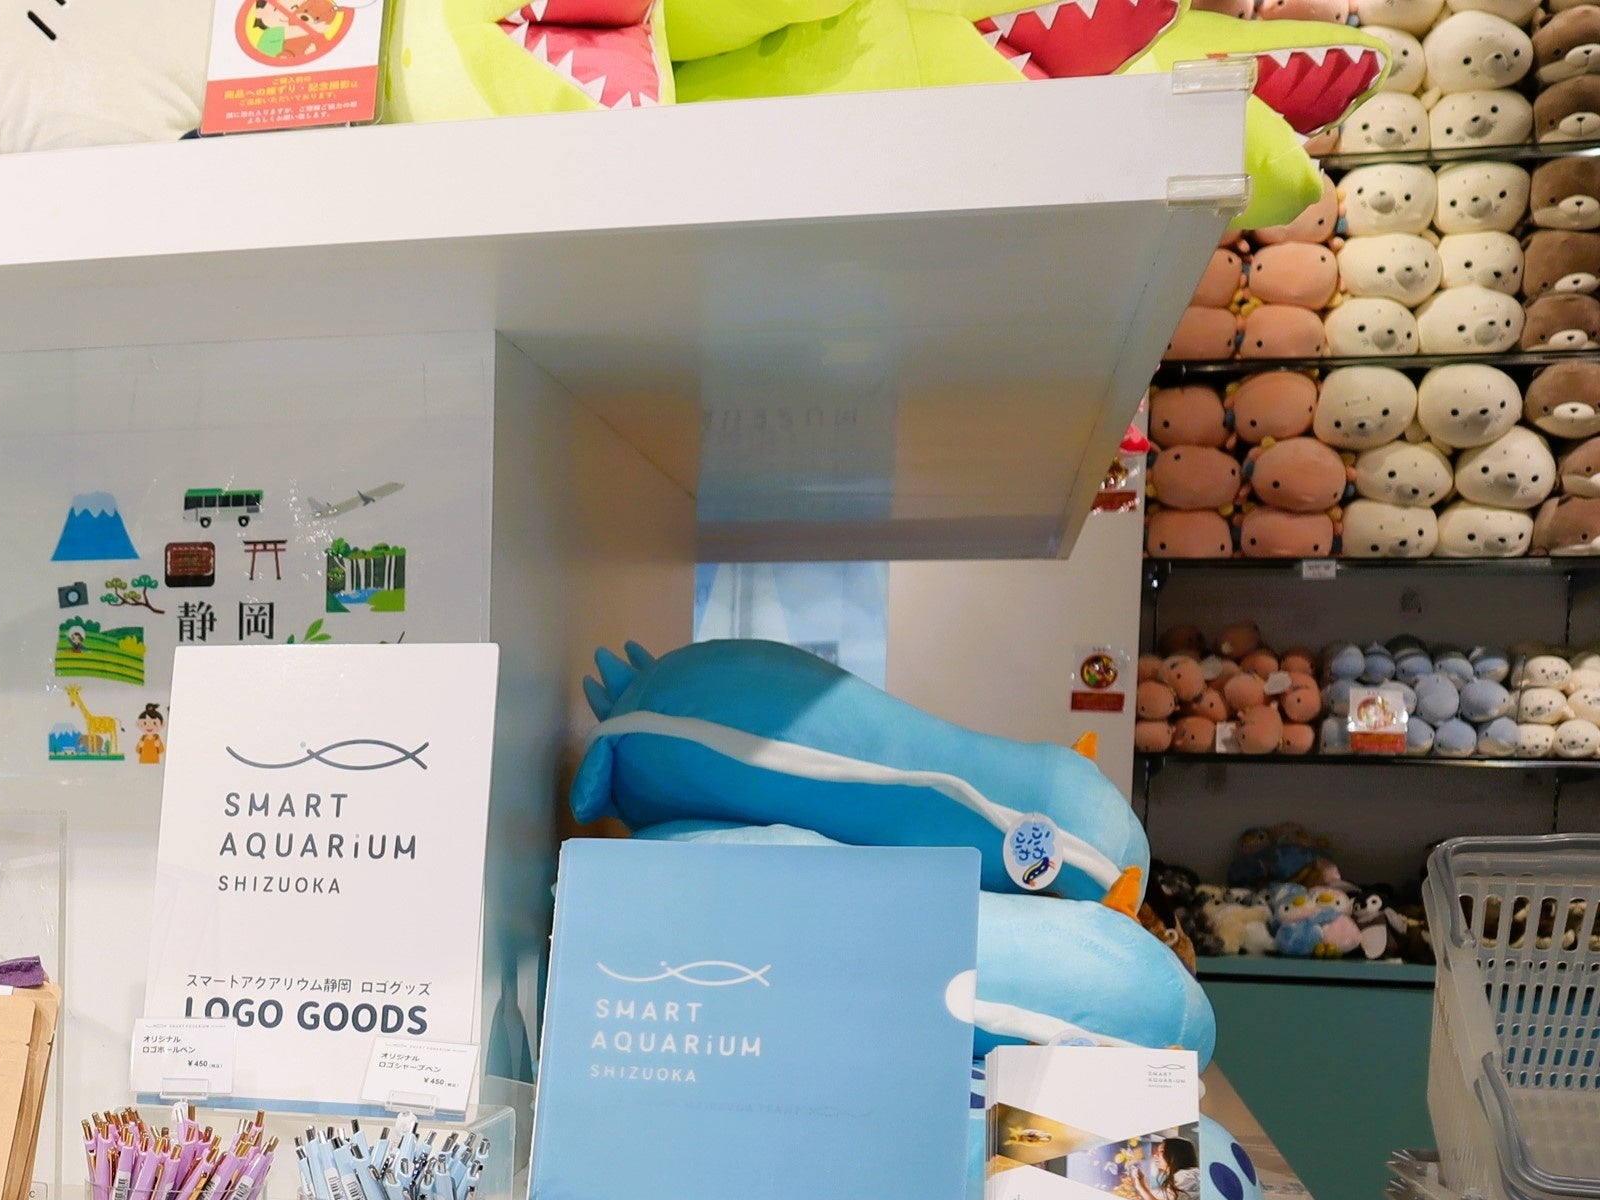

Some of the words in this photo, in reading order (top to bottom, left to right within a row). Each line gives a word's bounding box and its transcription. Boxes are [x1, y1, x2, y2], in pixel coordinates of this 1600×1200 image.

[177, 600, 275, 643] 静岡
[224, 792, 349, 819] SMART
[217, 875, 342, 895] SHIZUOKA
[185, 973, 352, 995] スマートアクアリウム静岡
[361, 978, 433, 997] ロゴグッズ
[184, 996, 284, 1030] LOGO
[297, 1000, 429, 1036] GOODS
[595, 998, 704, 1023] SMART
[143, 1035, 182, 1044] オリジナル
[187, 1060, 208, 1068] ¥450
[380, 1052, 420, 1062] オリジナル
[423, 1077, 445, 1085] ¥450
[589, 1064, 697, 1083] SHIZUOKA
